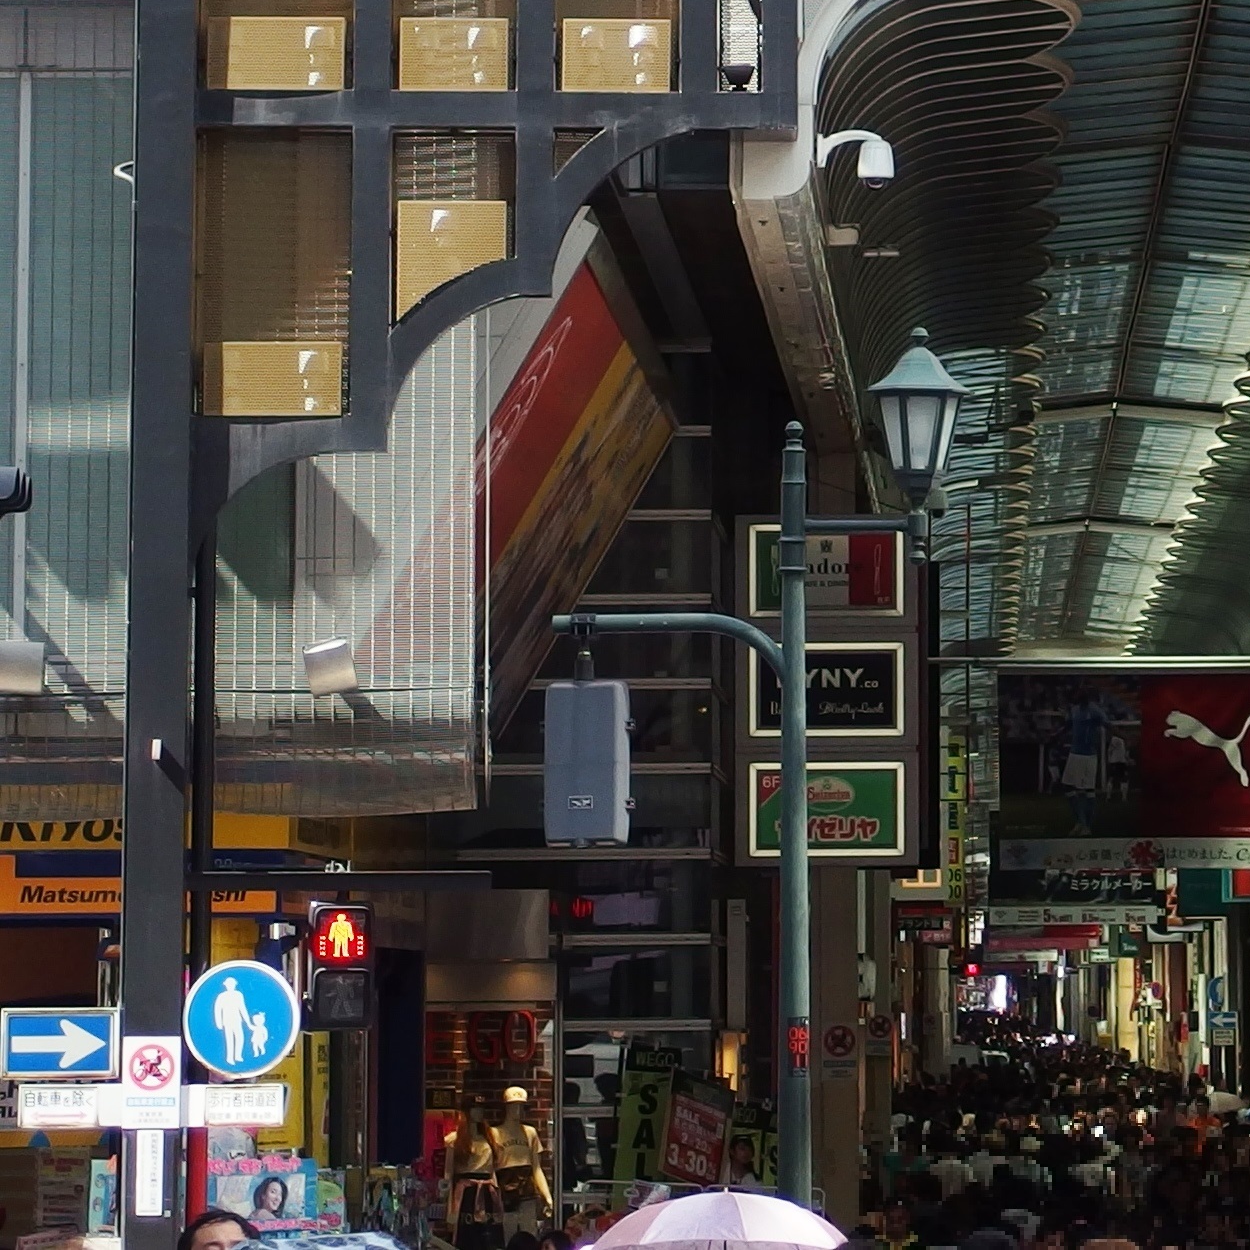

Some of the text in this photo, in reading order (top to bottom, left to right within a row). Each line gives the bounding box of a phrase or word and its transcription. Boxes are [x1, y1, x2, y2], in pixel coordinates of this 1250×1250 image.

[762, 775, 782, 789] 6F
[774, 815, 881, 842] イゼリヤ
[24, 1089, 94, 1107] 自転車を除く
[208, 1091, 277, 1108] 歩行者用道路
